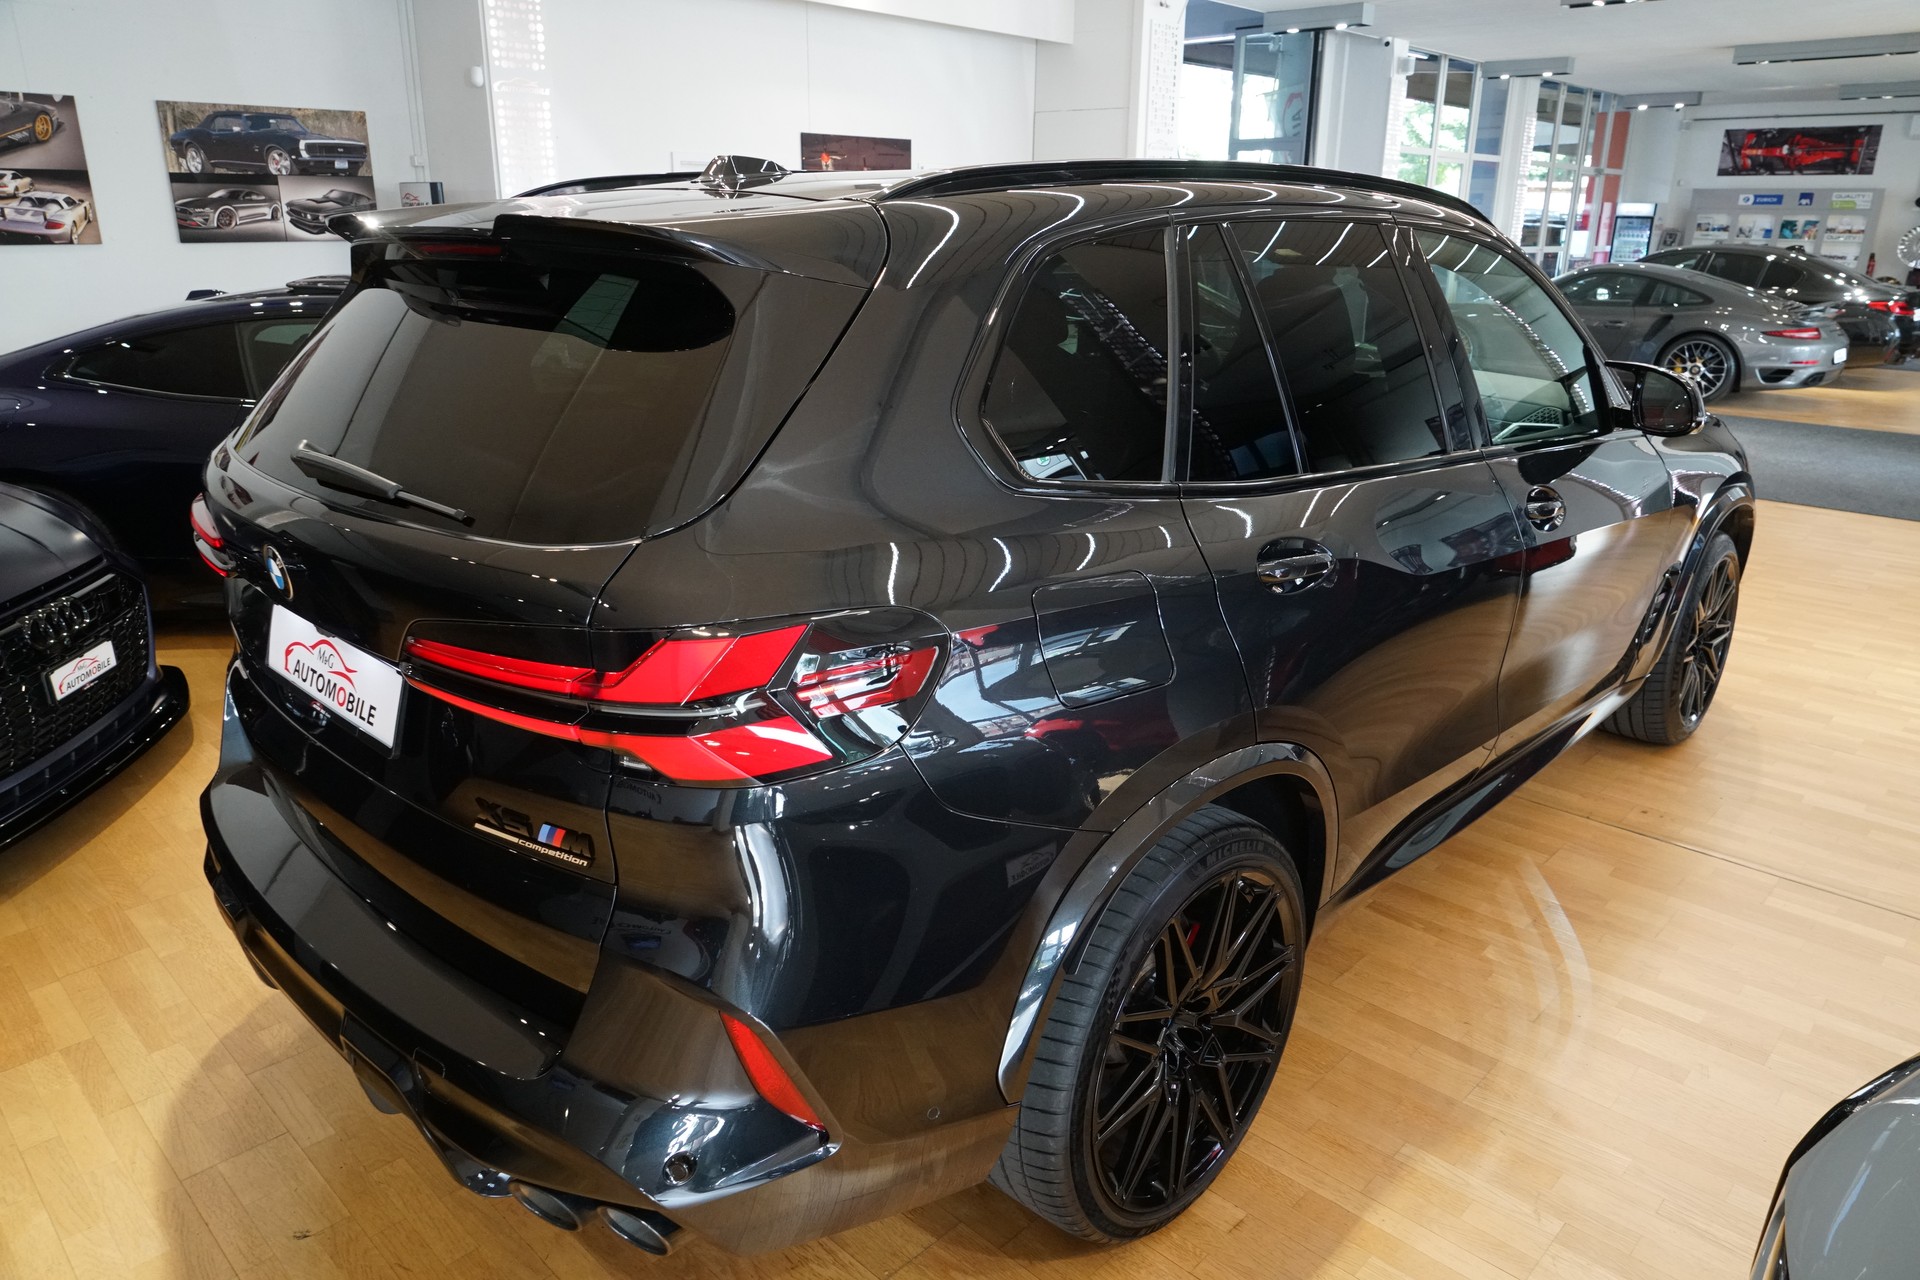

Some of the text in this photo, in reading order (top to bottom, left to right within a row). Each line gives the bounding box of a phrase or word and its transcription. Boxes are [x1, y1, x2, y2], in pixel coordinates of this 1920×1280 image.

[66, 657, 111, 691] AUTOMOBILE
[293, 659, 377, 726] AUTOMOBILE
[517, 838, 588, 867] competition
[1206, 839, 1265, 867] MICHELIN
